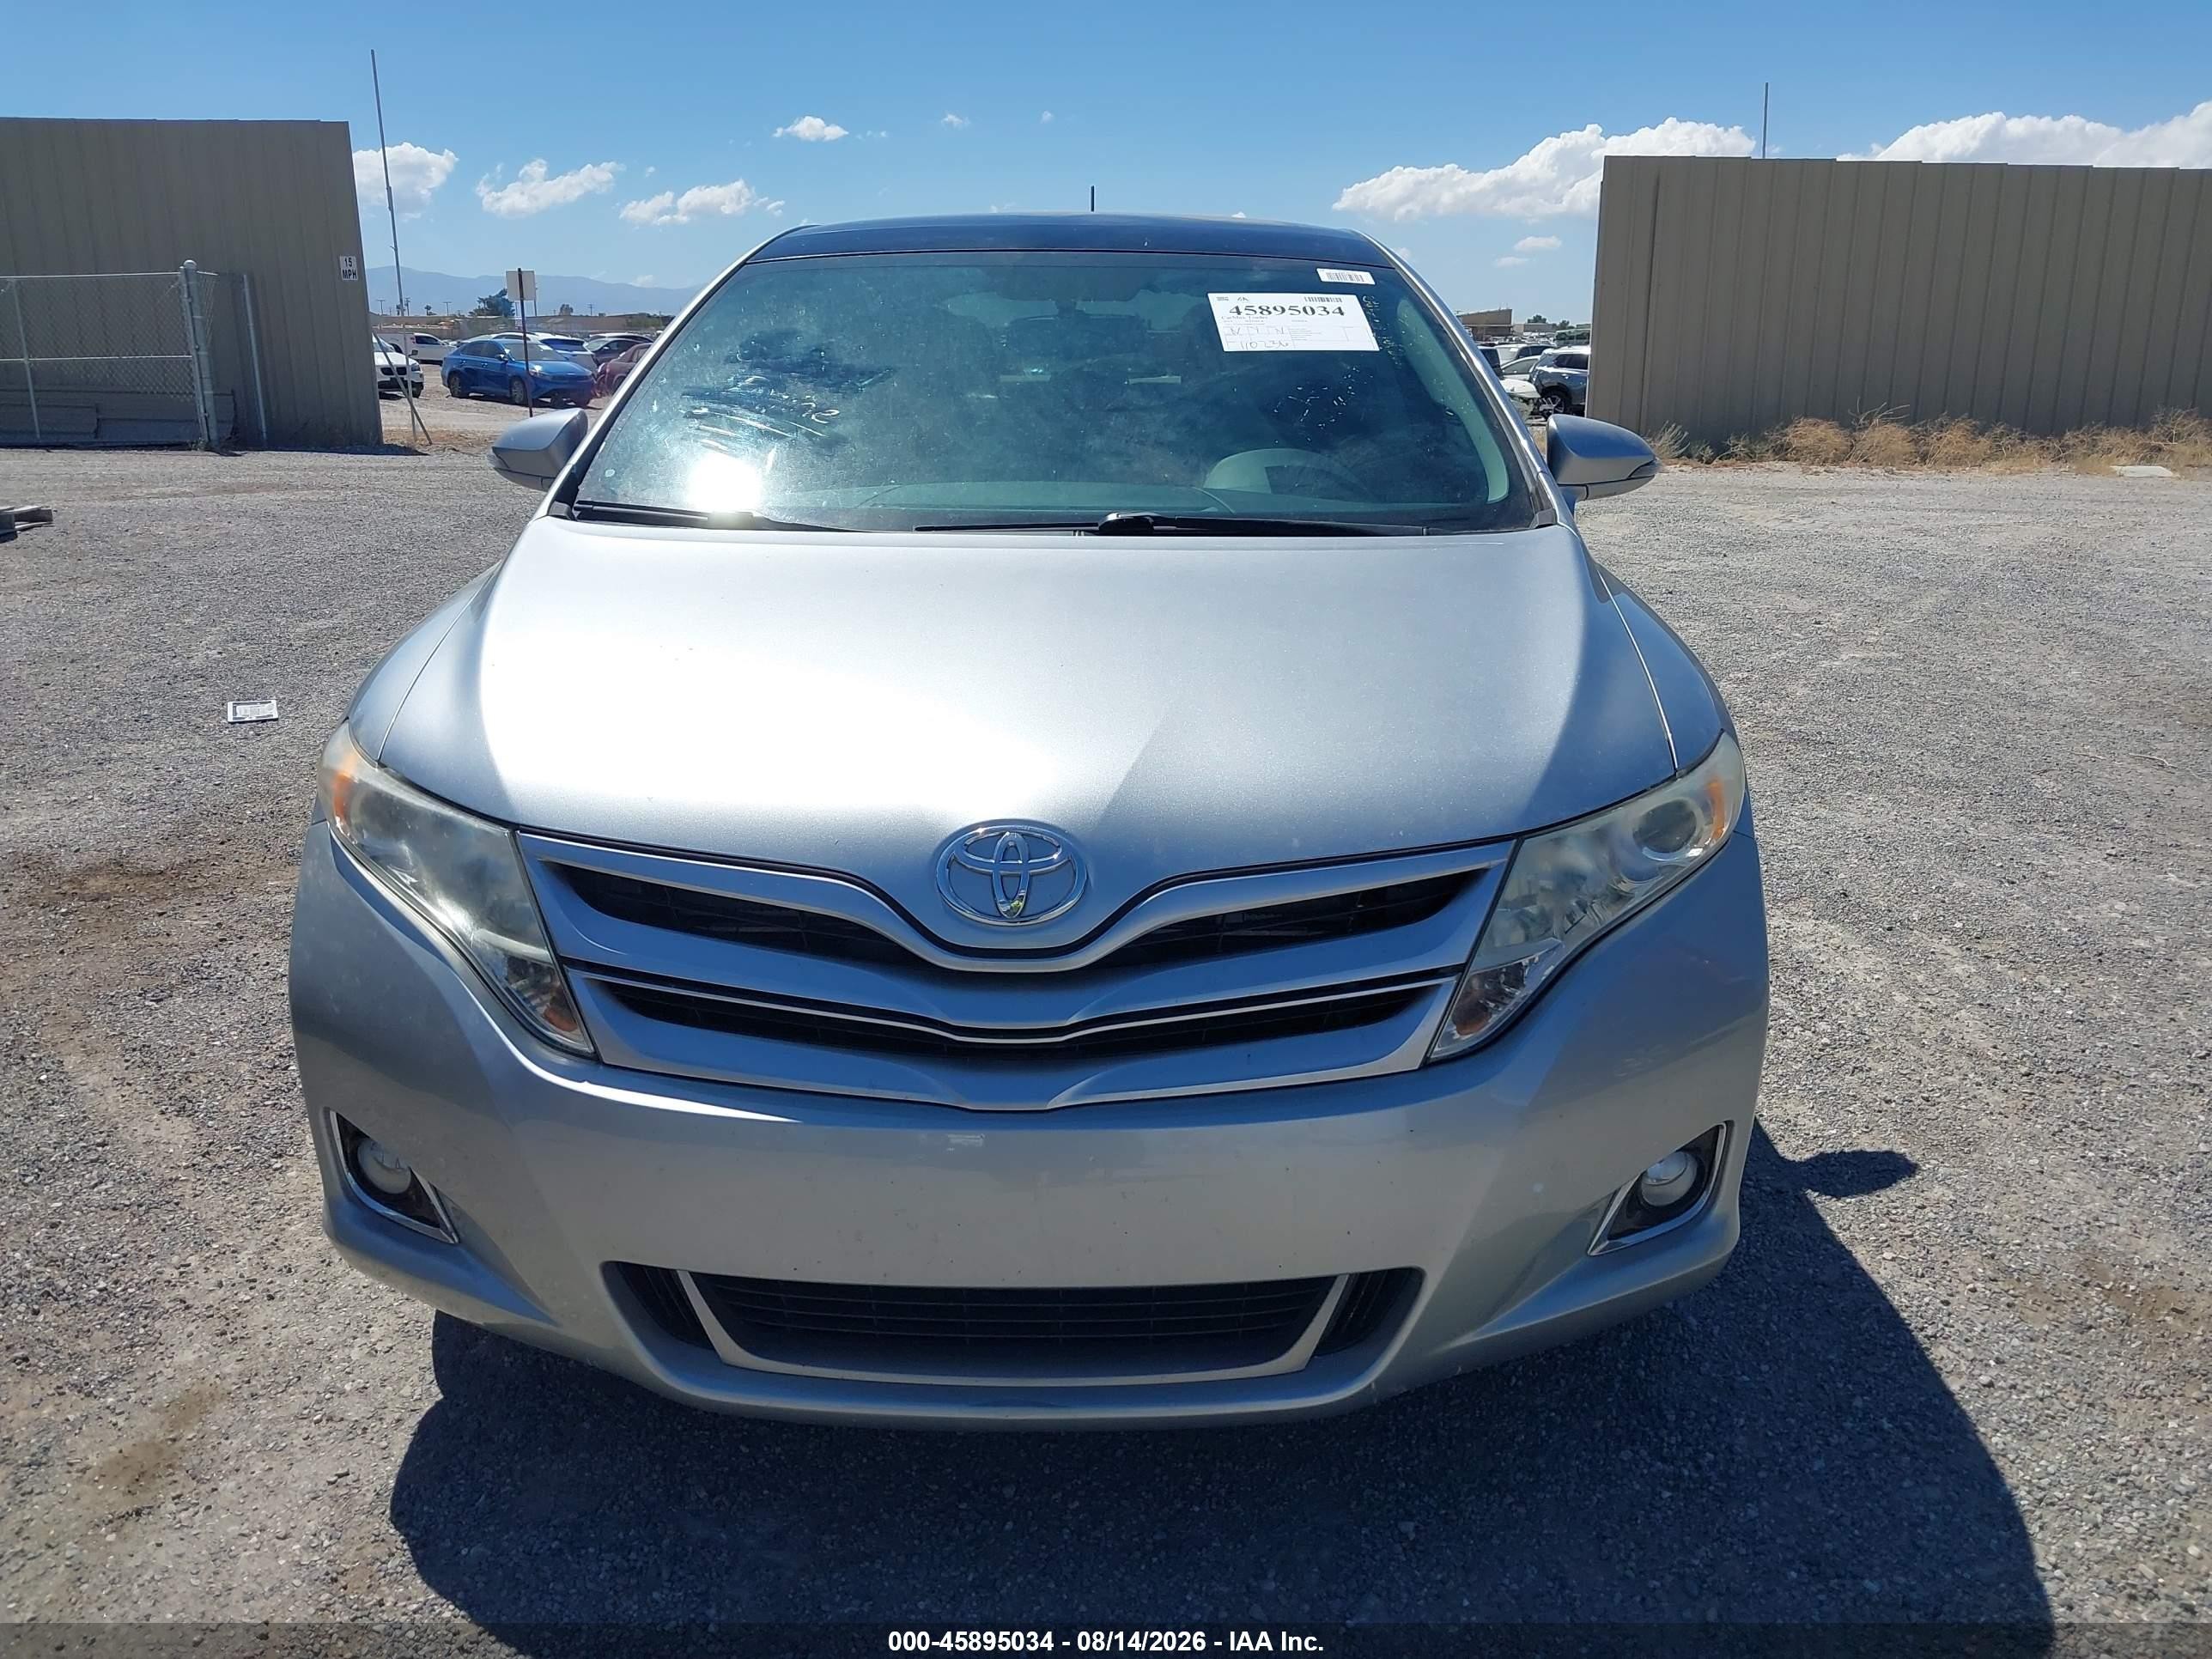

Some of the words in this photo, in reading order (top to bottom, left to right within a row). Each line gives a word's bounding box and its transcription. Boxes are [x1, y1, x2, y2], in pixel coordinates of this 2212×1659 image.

[344, 257, 353, 267] 15
[343, 269, 357, 279] MPH
[1229, 305, 1346, 316] 45895034
